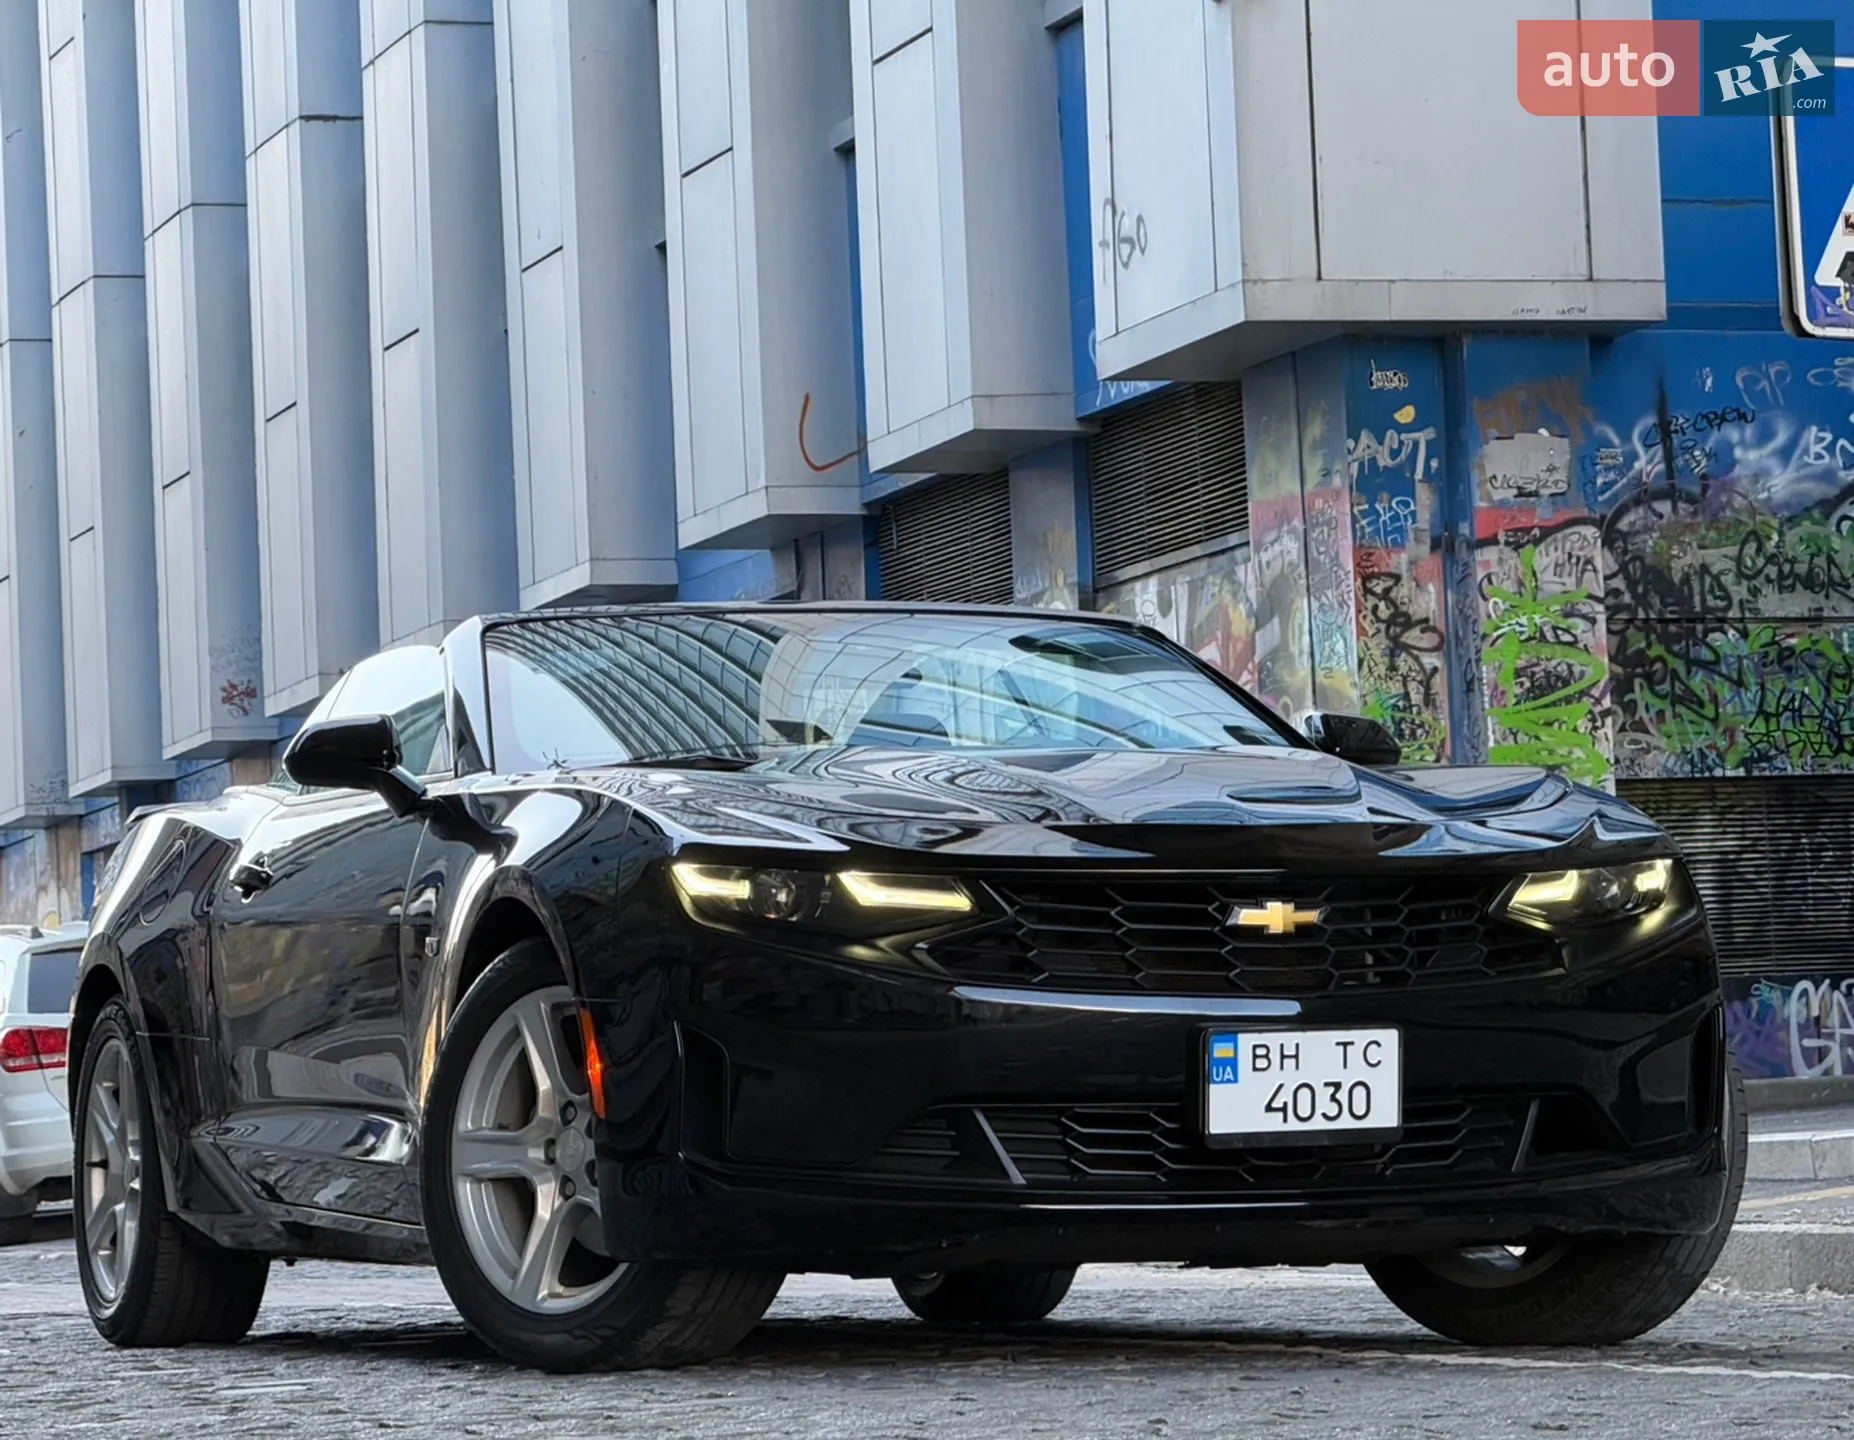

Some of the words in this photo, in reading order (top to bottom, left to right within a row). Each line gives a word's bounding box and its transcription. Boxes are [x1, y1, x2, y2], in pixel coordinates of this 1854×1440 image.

[1252, 1042, 1300, 1072] BH
[1335, 1040, 1382, 1070] TC
[1212, 1066, 1235, 1081] UA
[1264, 1080, 1372, 1124] 4030
